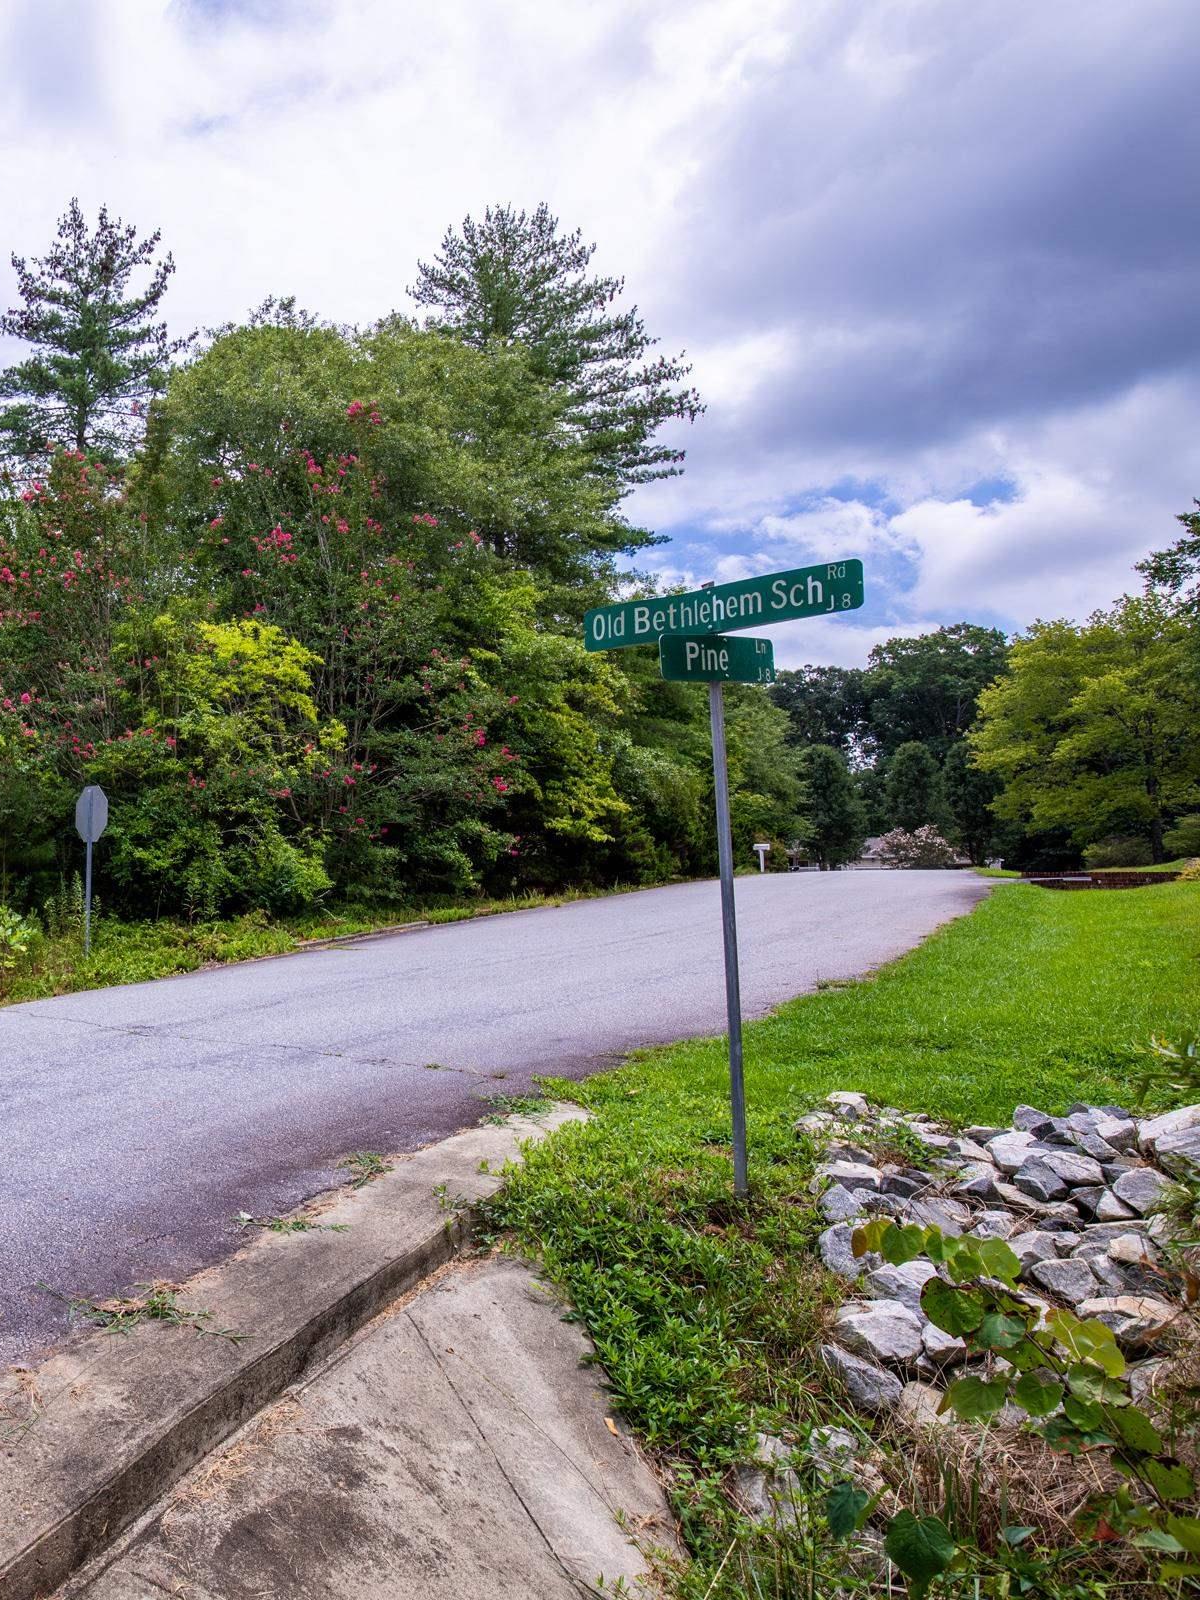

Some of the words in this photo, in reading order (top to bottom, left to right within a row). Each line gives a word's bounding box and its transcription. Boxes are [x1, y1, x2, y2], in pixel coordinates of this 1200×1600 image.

[592, 614, 624, 641] Old
[634, 592, 762, 634] Bethlehem
[770, 576, 823, 609] Sch
[827, 563, 846, 580] Rd
[685, 642, 729, 671] Pine
[755, 639, 766, 654] Ln
